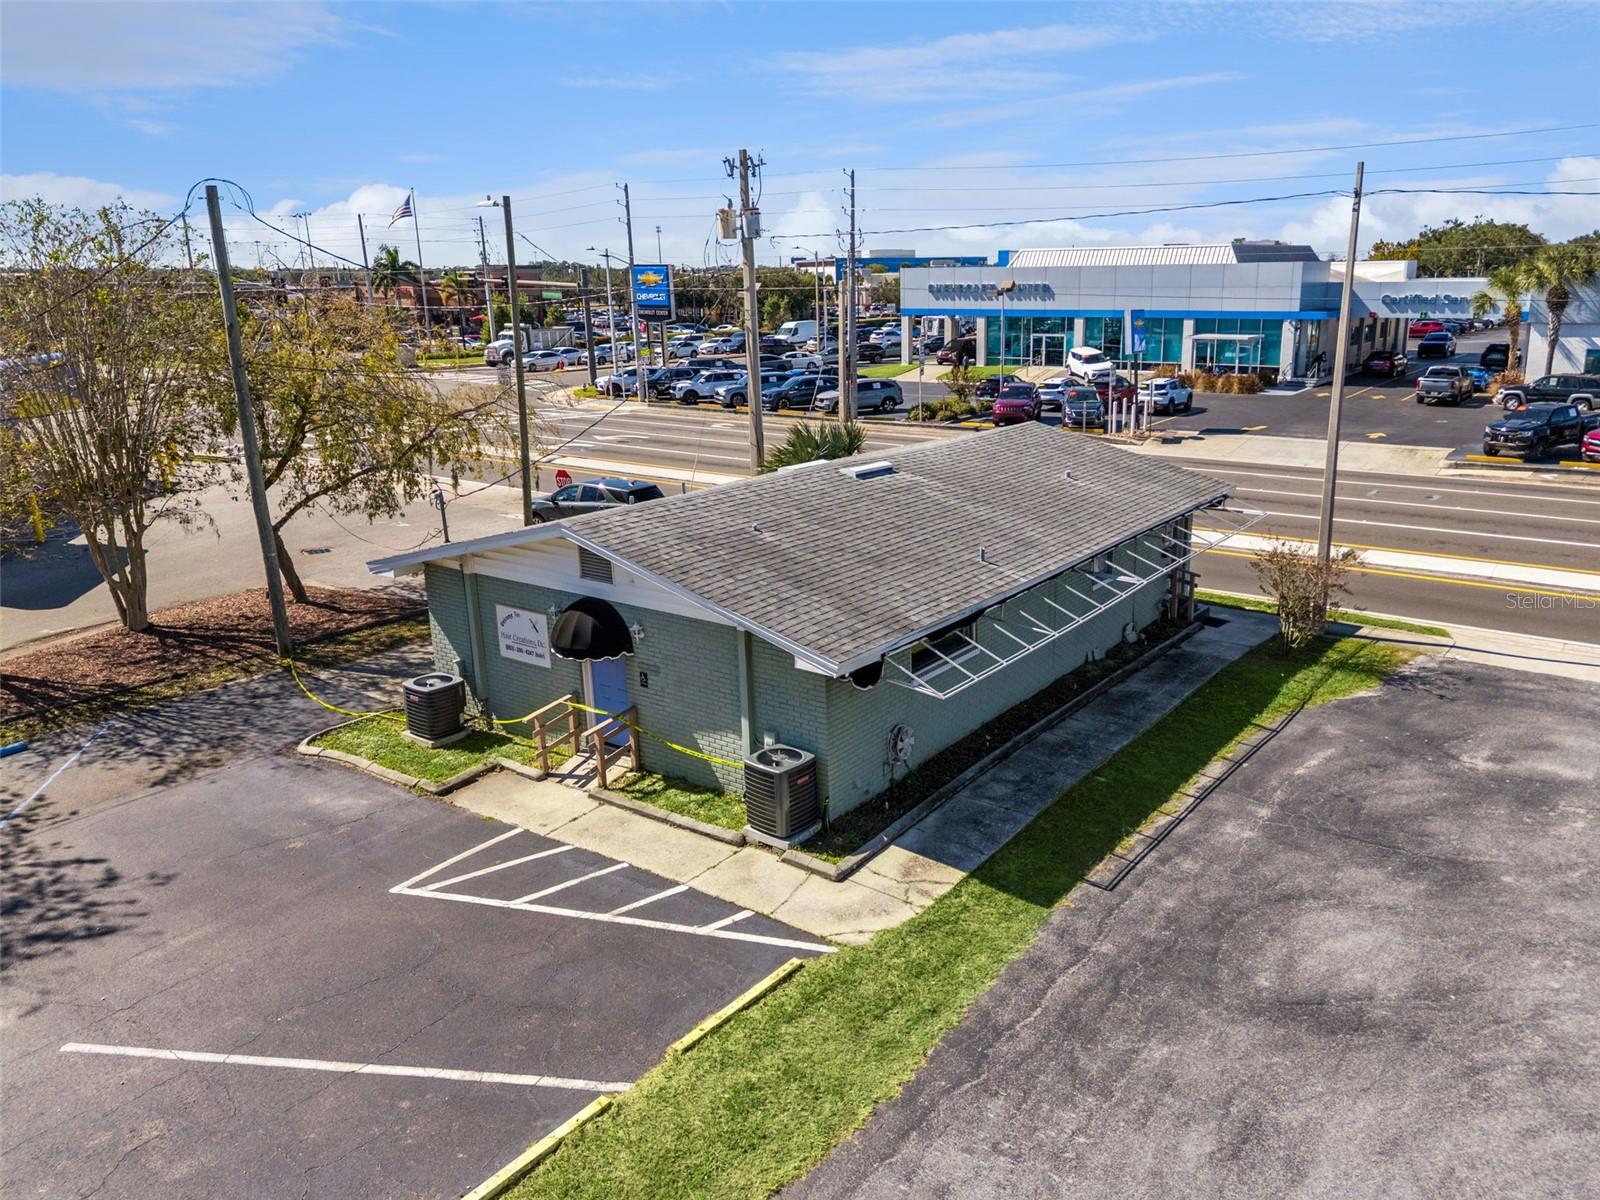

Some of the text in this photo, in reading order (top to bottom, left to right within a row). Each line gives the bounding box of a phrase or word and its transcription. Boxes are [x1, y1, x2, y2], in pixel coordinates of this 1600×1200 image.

[927, 282, 997, 294] CHEVROLET
[636, 293, 666, 301] CHEVROLET
[1382, 294, 1441, 305] Certified
[556, 476, 572, 487] STOP
[501, 631, 512, 640] Hair
